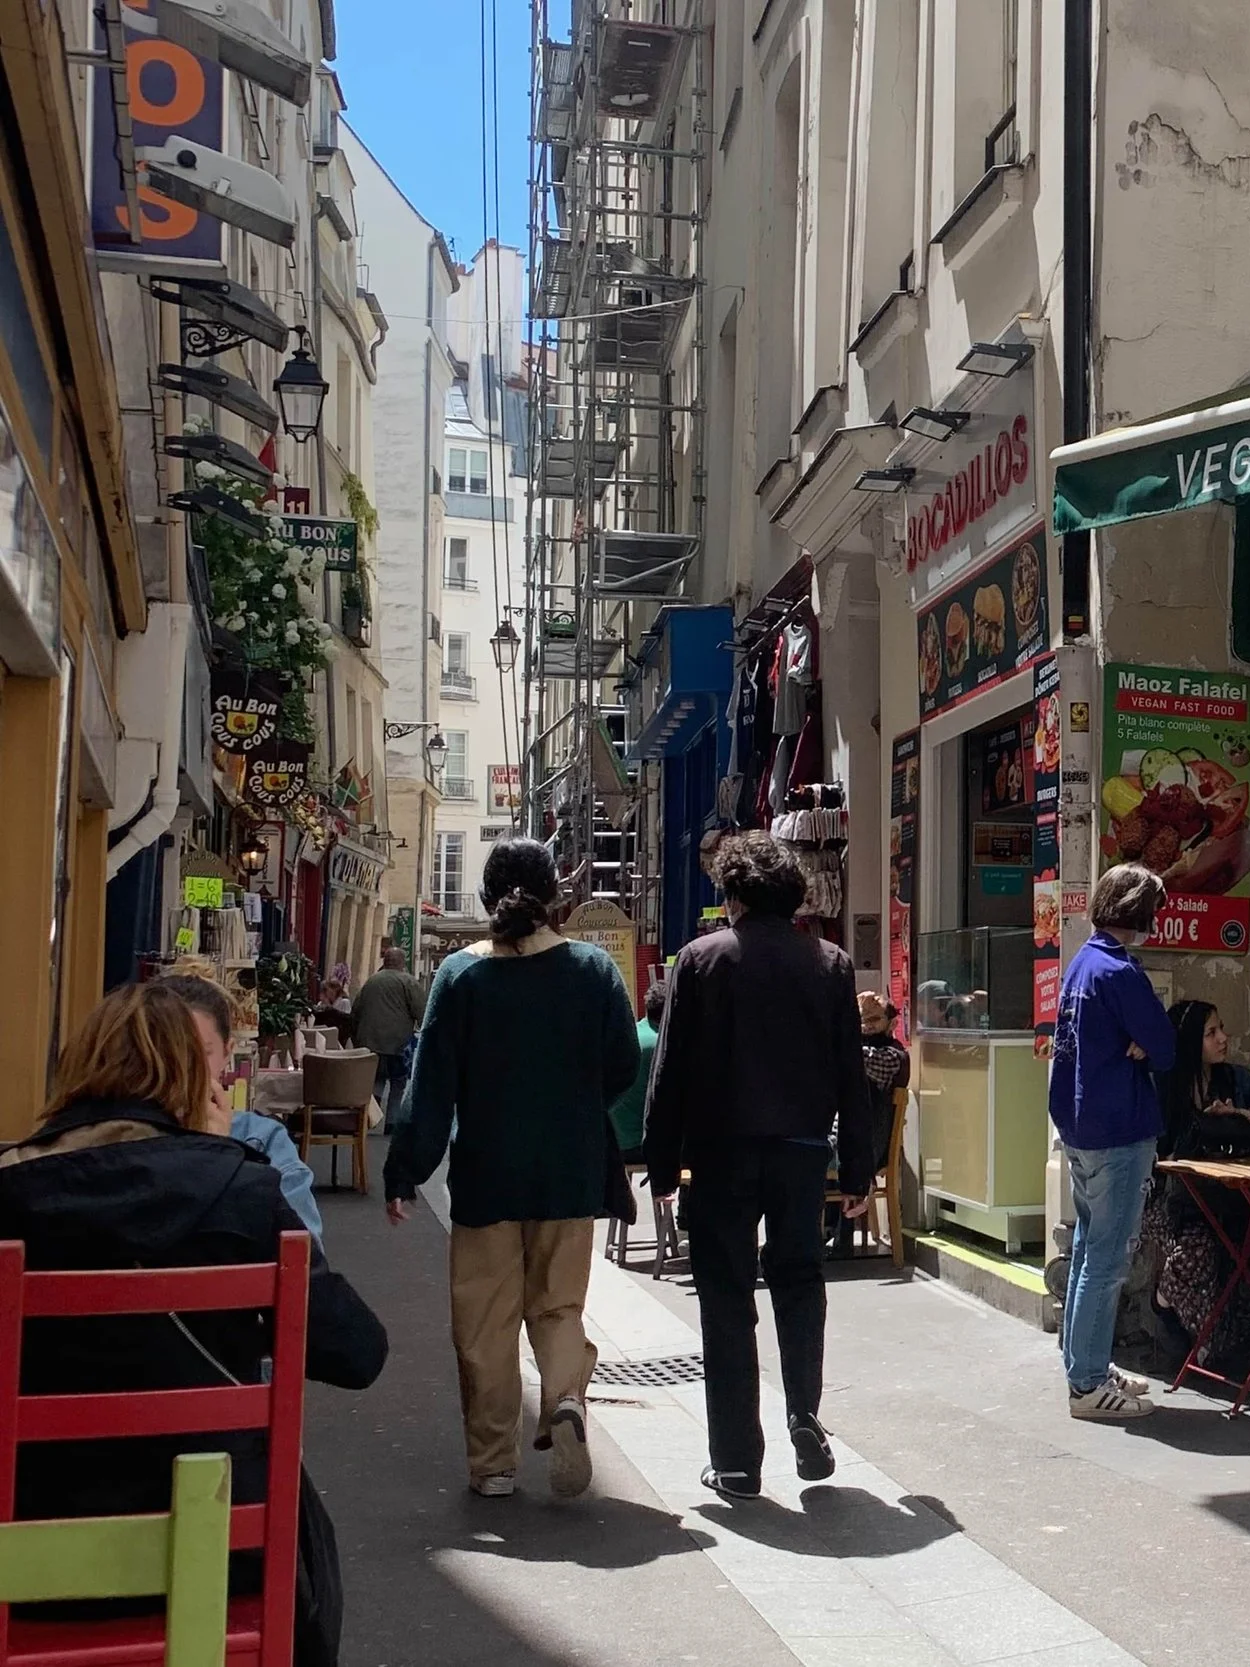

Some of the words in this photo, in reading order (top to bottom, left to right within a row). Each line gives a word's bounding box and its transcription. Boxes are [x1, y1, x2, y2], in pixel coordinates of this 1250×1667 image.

[906, 415, 1030, 573] BOCADILLOS
[300, 526, 337, 541] BON
[1118, 671, 1173, 694] Maoz
[1179, 678, 1248, 700] Falafel
[215, 695, 243, 711] Au
[246, 698, 278, 716] Bon
[1131, 697, 1167, 709] VEGAN
[1174, 701, 1200, 713] FAST
[1207, 704, 1235, 716] FOOD
[1118, 714, 1137, 725] Pita
[1139, 715, 1166, 728] blanc
[1118, 729, 1124, 738] 5
[1127, 730, 1164, 742] Falafels
[252, 760, 275, 774] Au
[278, 761, 304, 773] Bon
[1177, 898, 1208, 912] Salade
[598, 931, 618, 941] Bon
[1188, 918, 1199, 942] €
